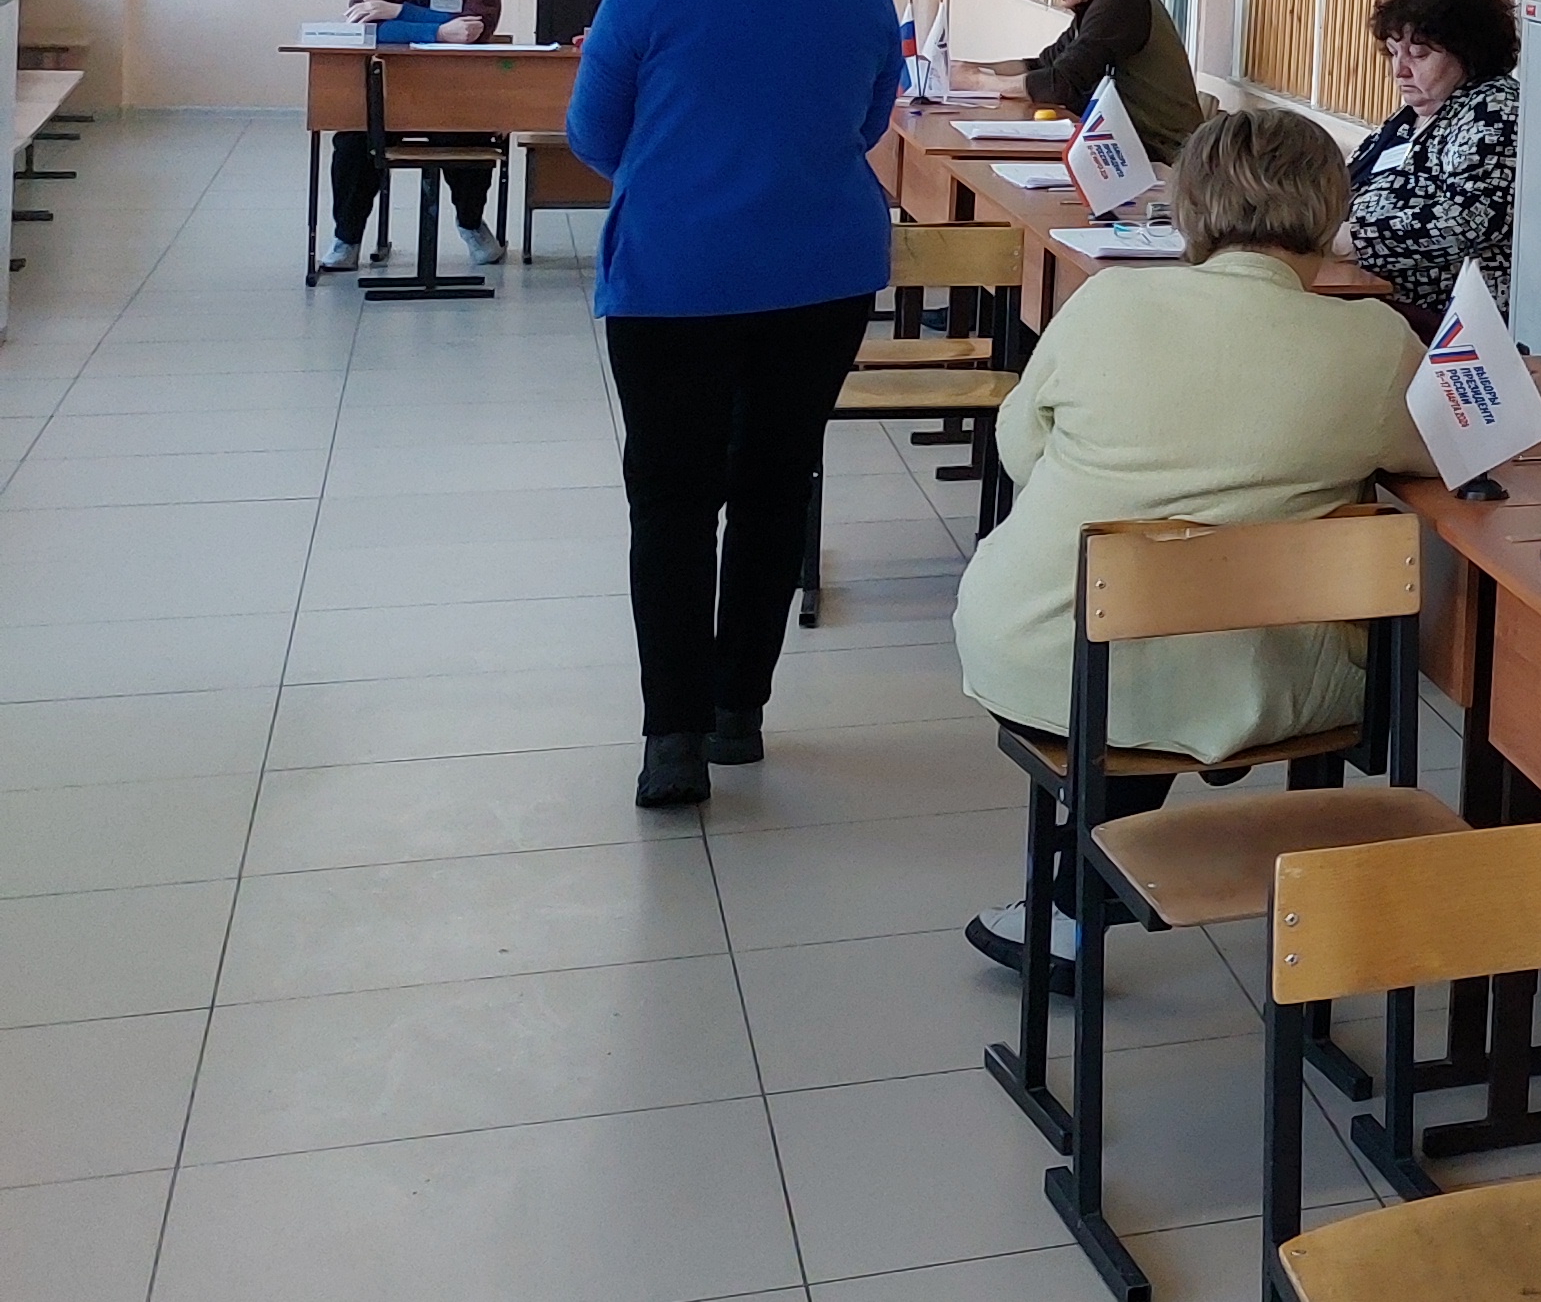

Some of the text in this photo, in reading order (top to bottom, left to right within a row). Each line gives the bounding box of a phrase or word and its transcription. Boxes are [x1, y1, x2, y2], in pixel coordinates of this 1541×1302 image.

[1446, 369, 1473, 405] РОССИИ
[1459, 368, 1496, 425] ПРЕЗИДЕНТА
[1473, 366, 1501, 406] ВЫБОРЫ
